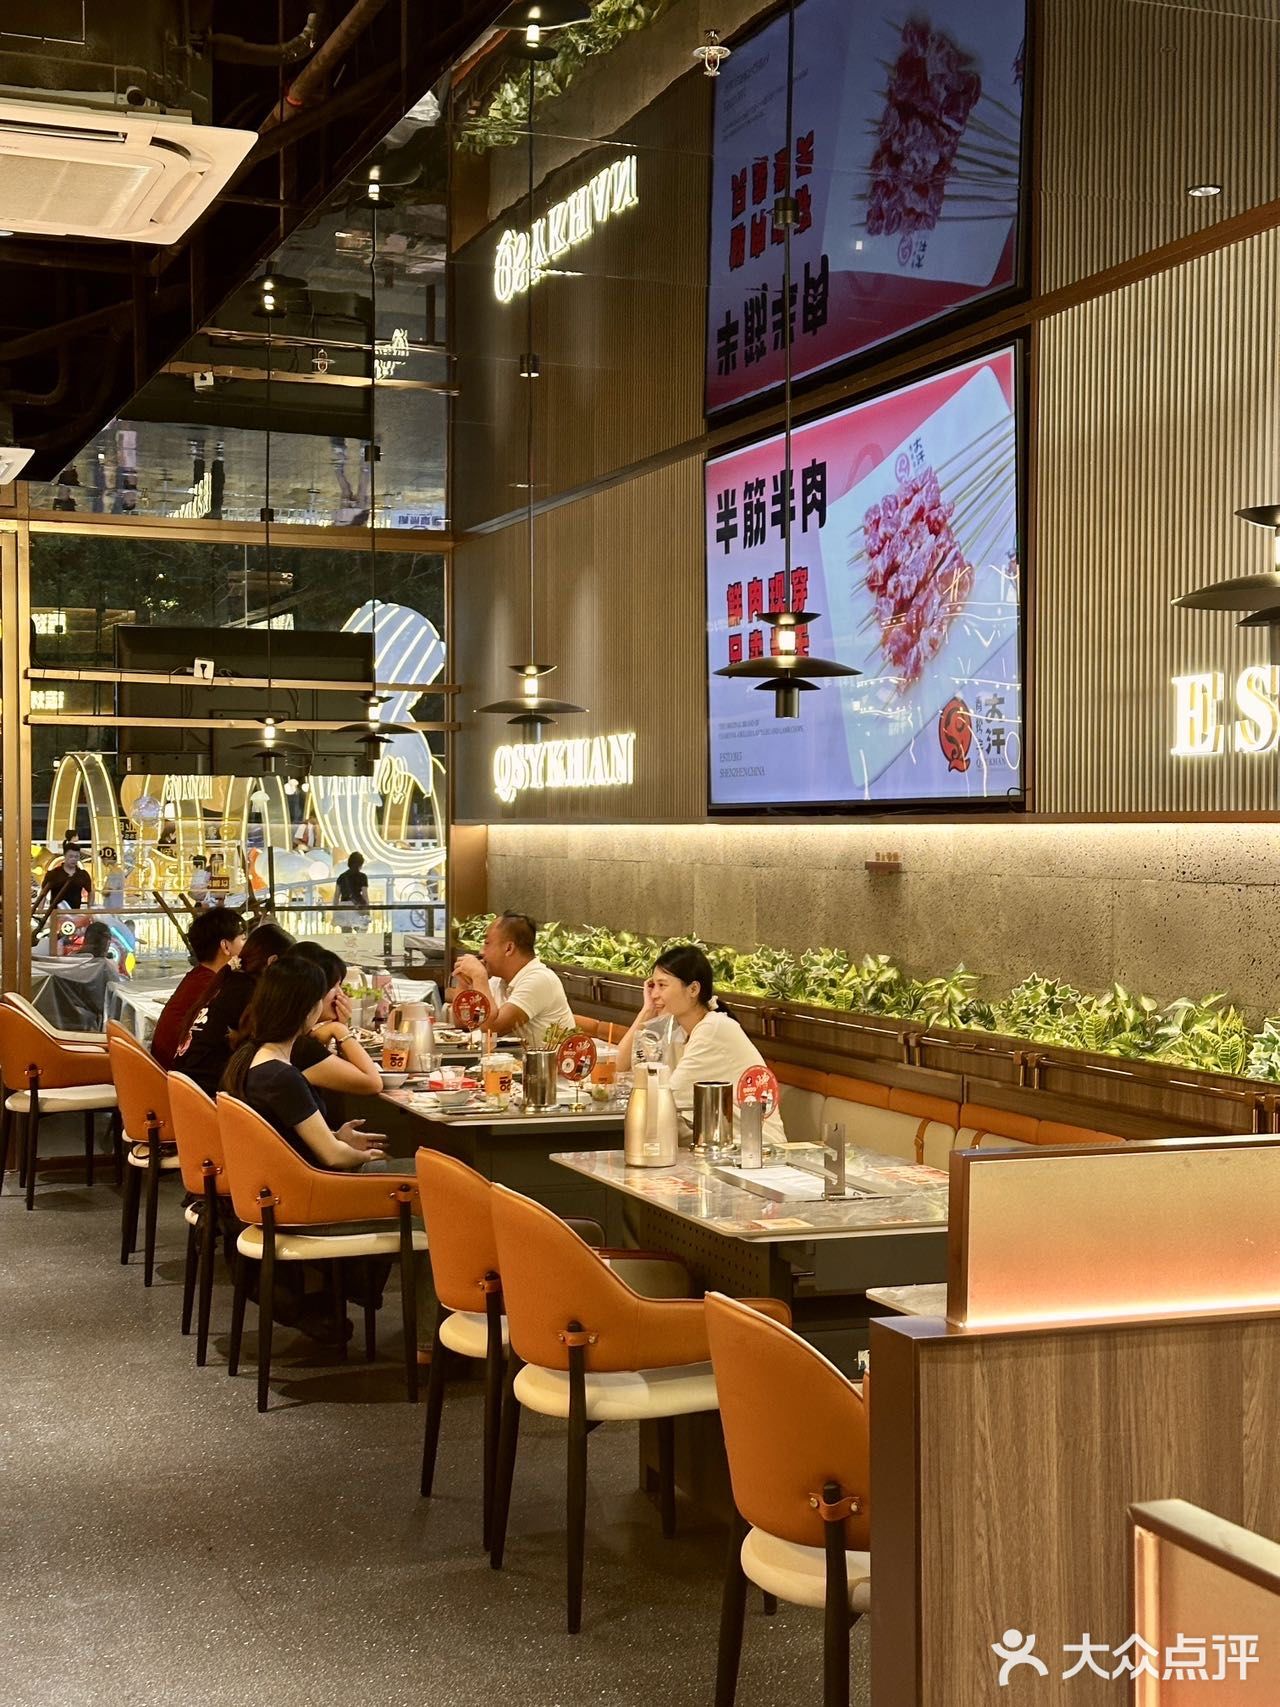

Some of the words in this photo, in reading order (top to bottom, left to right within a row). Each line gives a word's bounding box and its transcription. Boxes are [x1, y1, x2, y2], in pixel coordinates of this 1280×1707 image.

[716, 458, 827, 555] 半筋半肉
[493, 732, 636, 803] QSYKHAN
